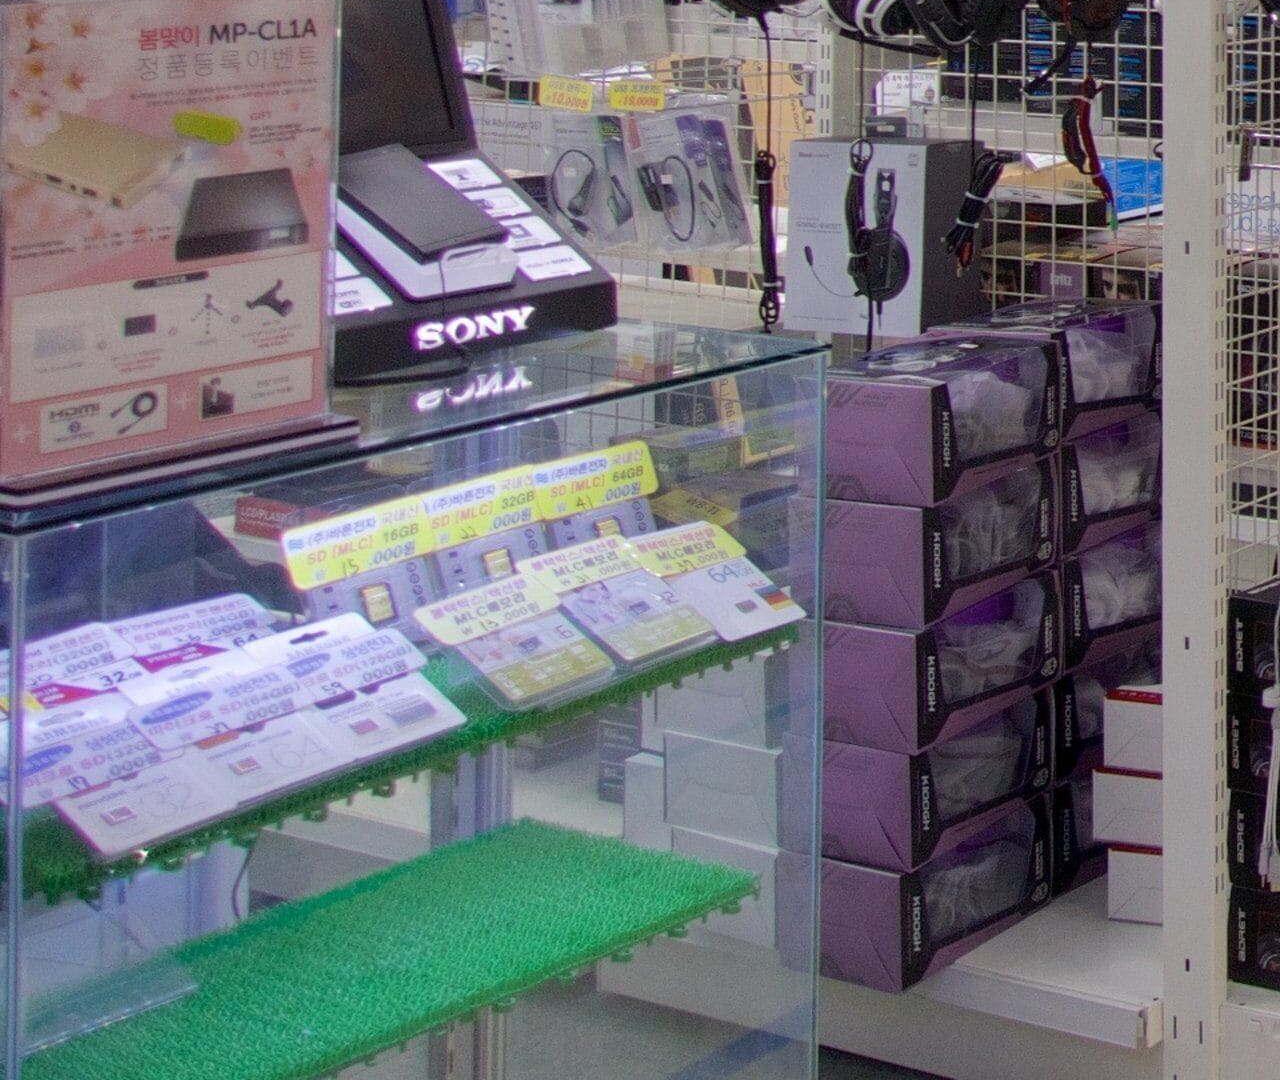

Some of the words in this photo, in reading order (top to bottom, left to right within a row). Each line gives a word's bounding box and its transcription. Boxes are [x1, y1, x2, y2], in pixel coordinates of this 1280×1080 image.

[139, 26, 201, 51] 봄맞이
[209, 18, 317, 45] MP-CL1A
[415, 305, 534, 351] SONY
[50, 403, 101, 420] HDMI
[549, 484, 567, 499] SD
[611, 465, 645, 484] 64GB
[501, 490, 535, 509] 32GB
[307, 551, 325, 565] SD
[383, 524, 419, 543] 16GB
